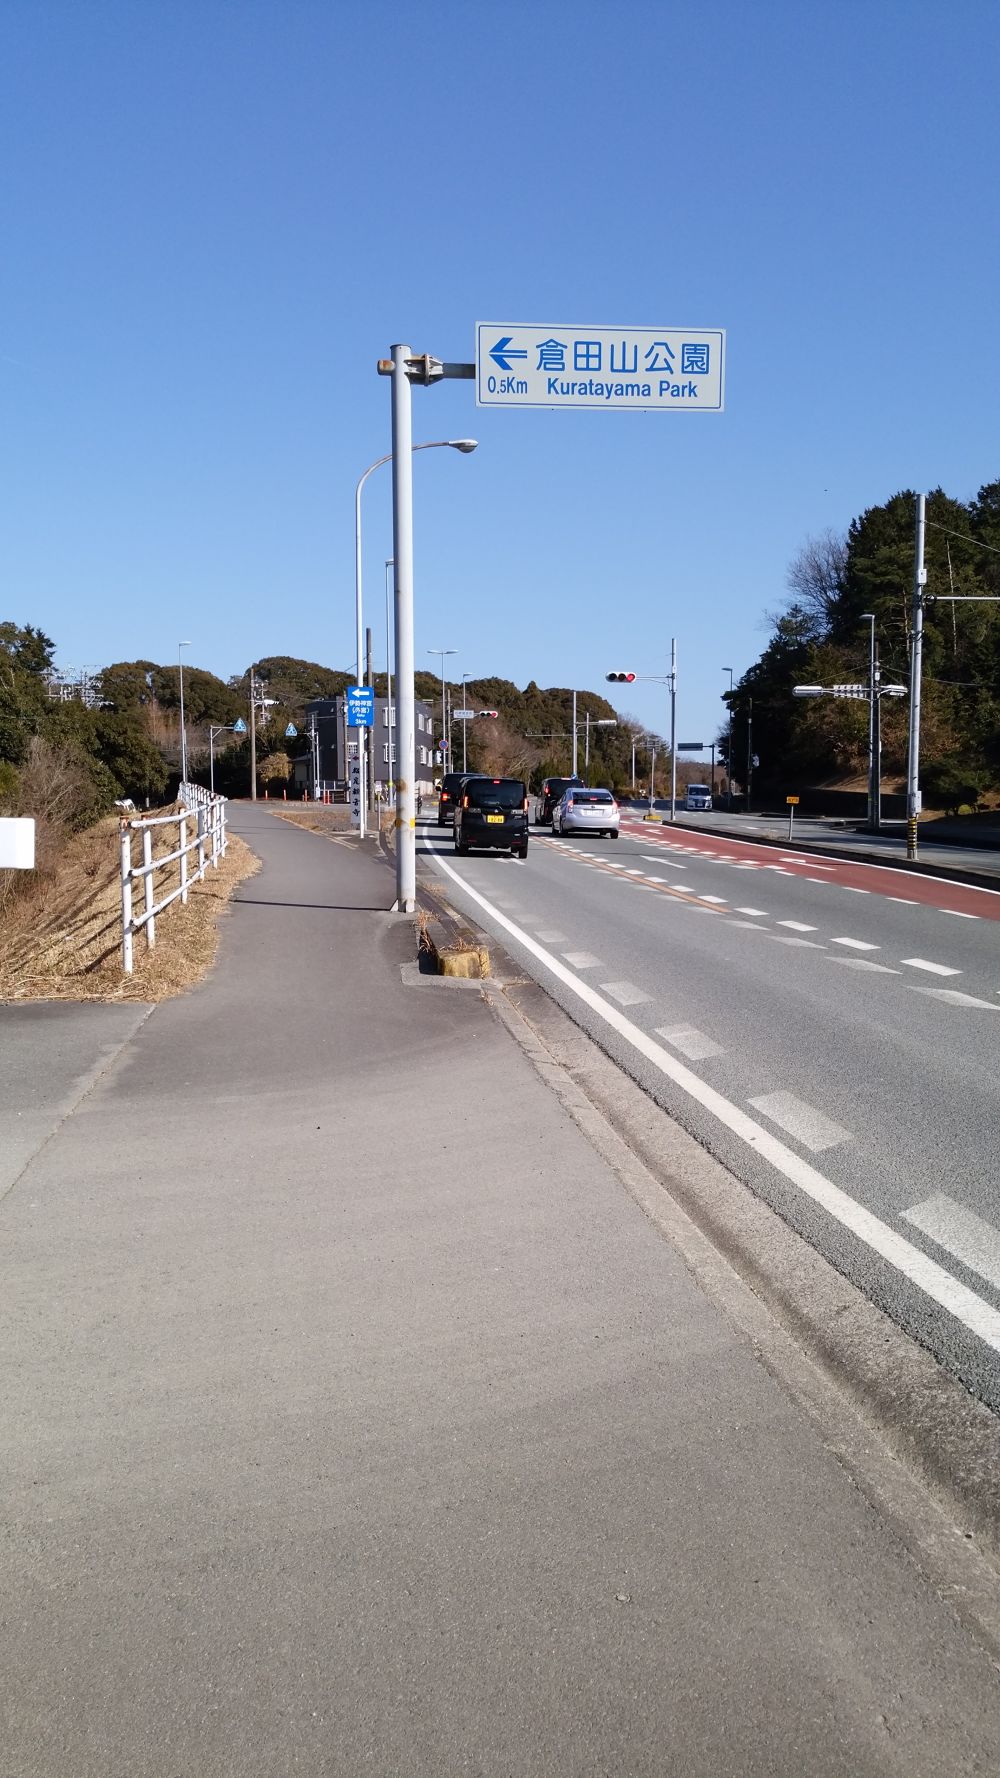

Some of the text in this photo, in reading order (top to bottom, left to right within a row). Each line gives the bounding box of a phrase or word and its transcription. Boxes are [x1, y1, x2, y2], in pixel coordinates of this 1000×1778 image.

[536, 338, 710, 375] 倉田山公園
[487, 375, 528, 395] 0.5Km
[547, 377, 698, 400] Kuratayama Park
